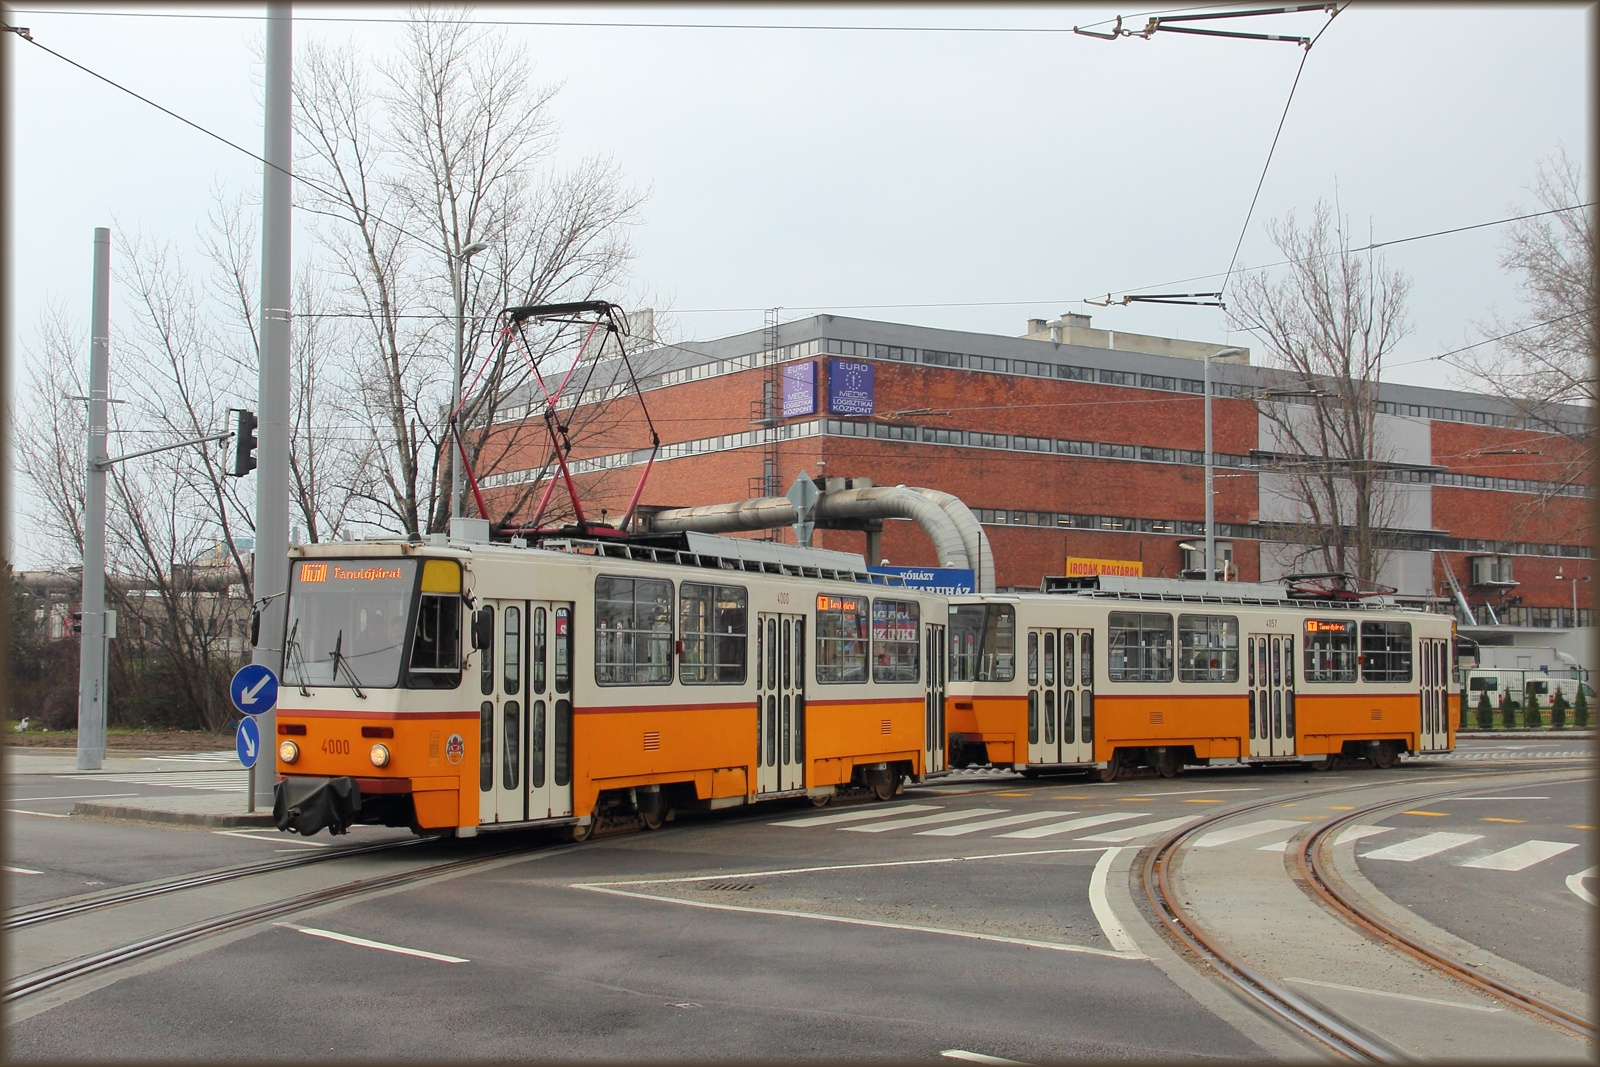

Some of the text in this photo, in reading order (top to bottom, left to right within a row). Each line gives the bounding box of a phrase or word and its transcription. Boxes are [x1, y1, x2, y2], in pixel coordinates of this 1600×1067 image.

[788, 363, 809, 374] EURO
[840, 362, 868, 372] EURO
[788, 391, 809, 400] MEDIC
[839, 390, 868, 399] MEDIC
[784, 400, 812, 410] LOGISZTIKAI
[833, 398, 872, 407] LOGISZTIKAI
[784, 405, 812, 416] KÖZPONT
[833, 405, 872, 414] KÖZPONT
[1070, 561, 1139, 576] IRODÁK RAKTÁRAK
[900, 570, 934, 580] KŐHÁZY
[1266, 619, 1277, 628] 4057
[322, 739, 350, 755] 4000
